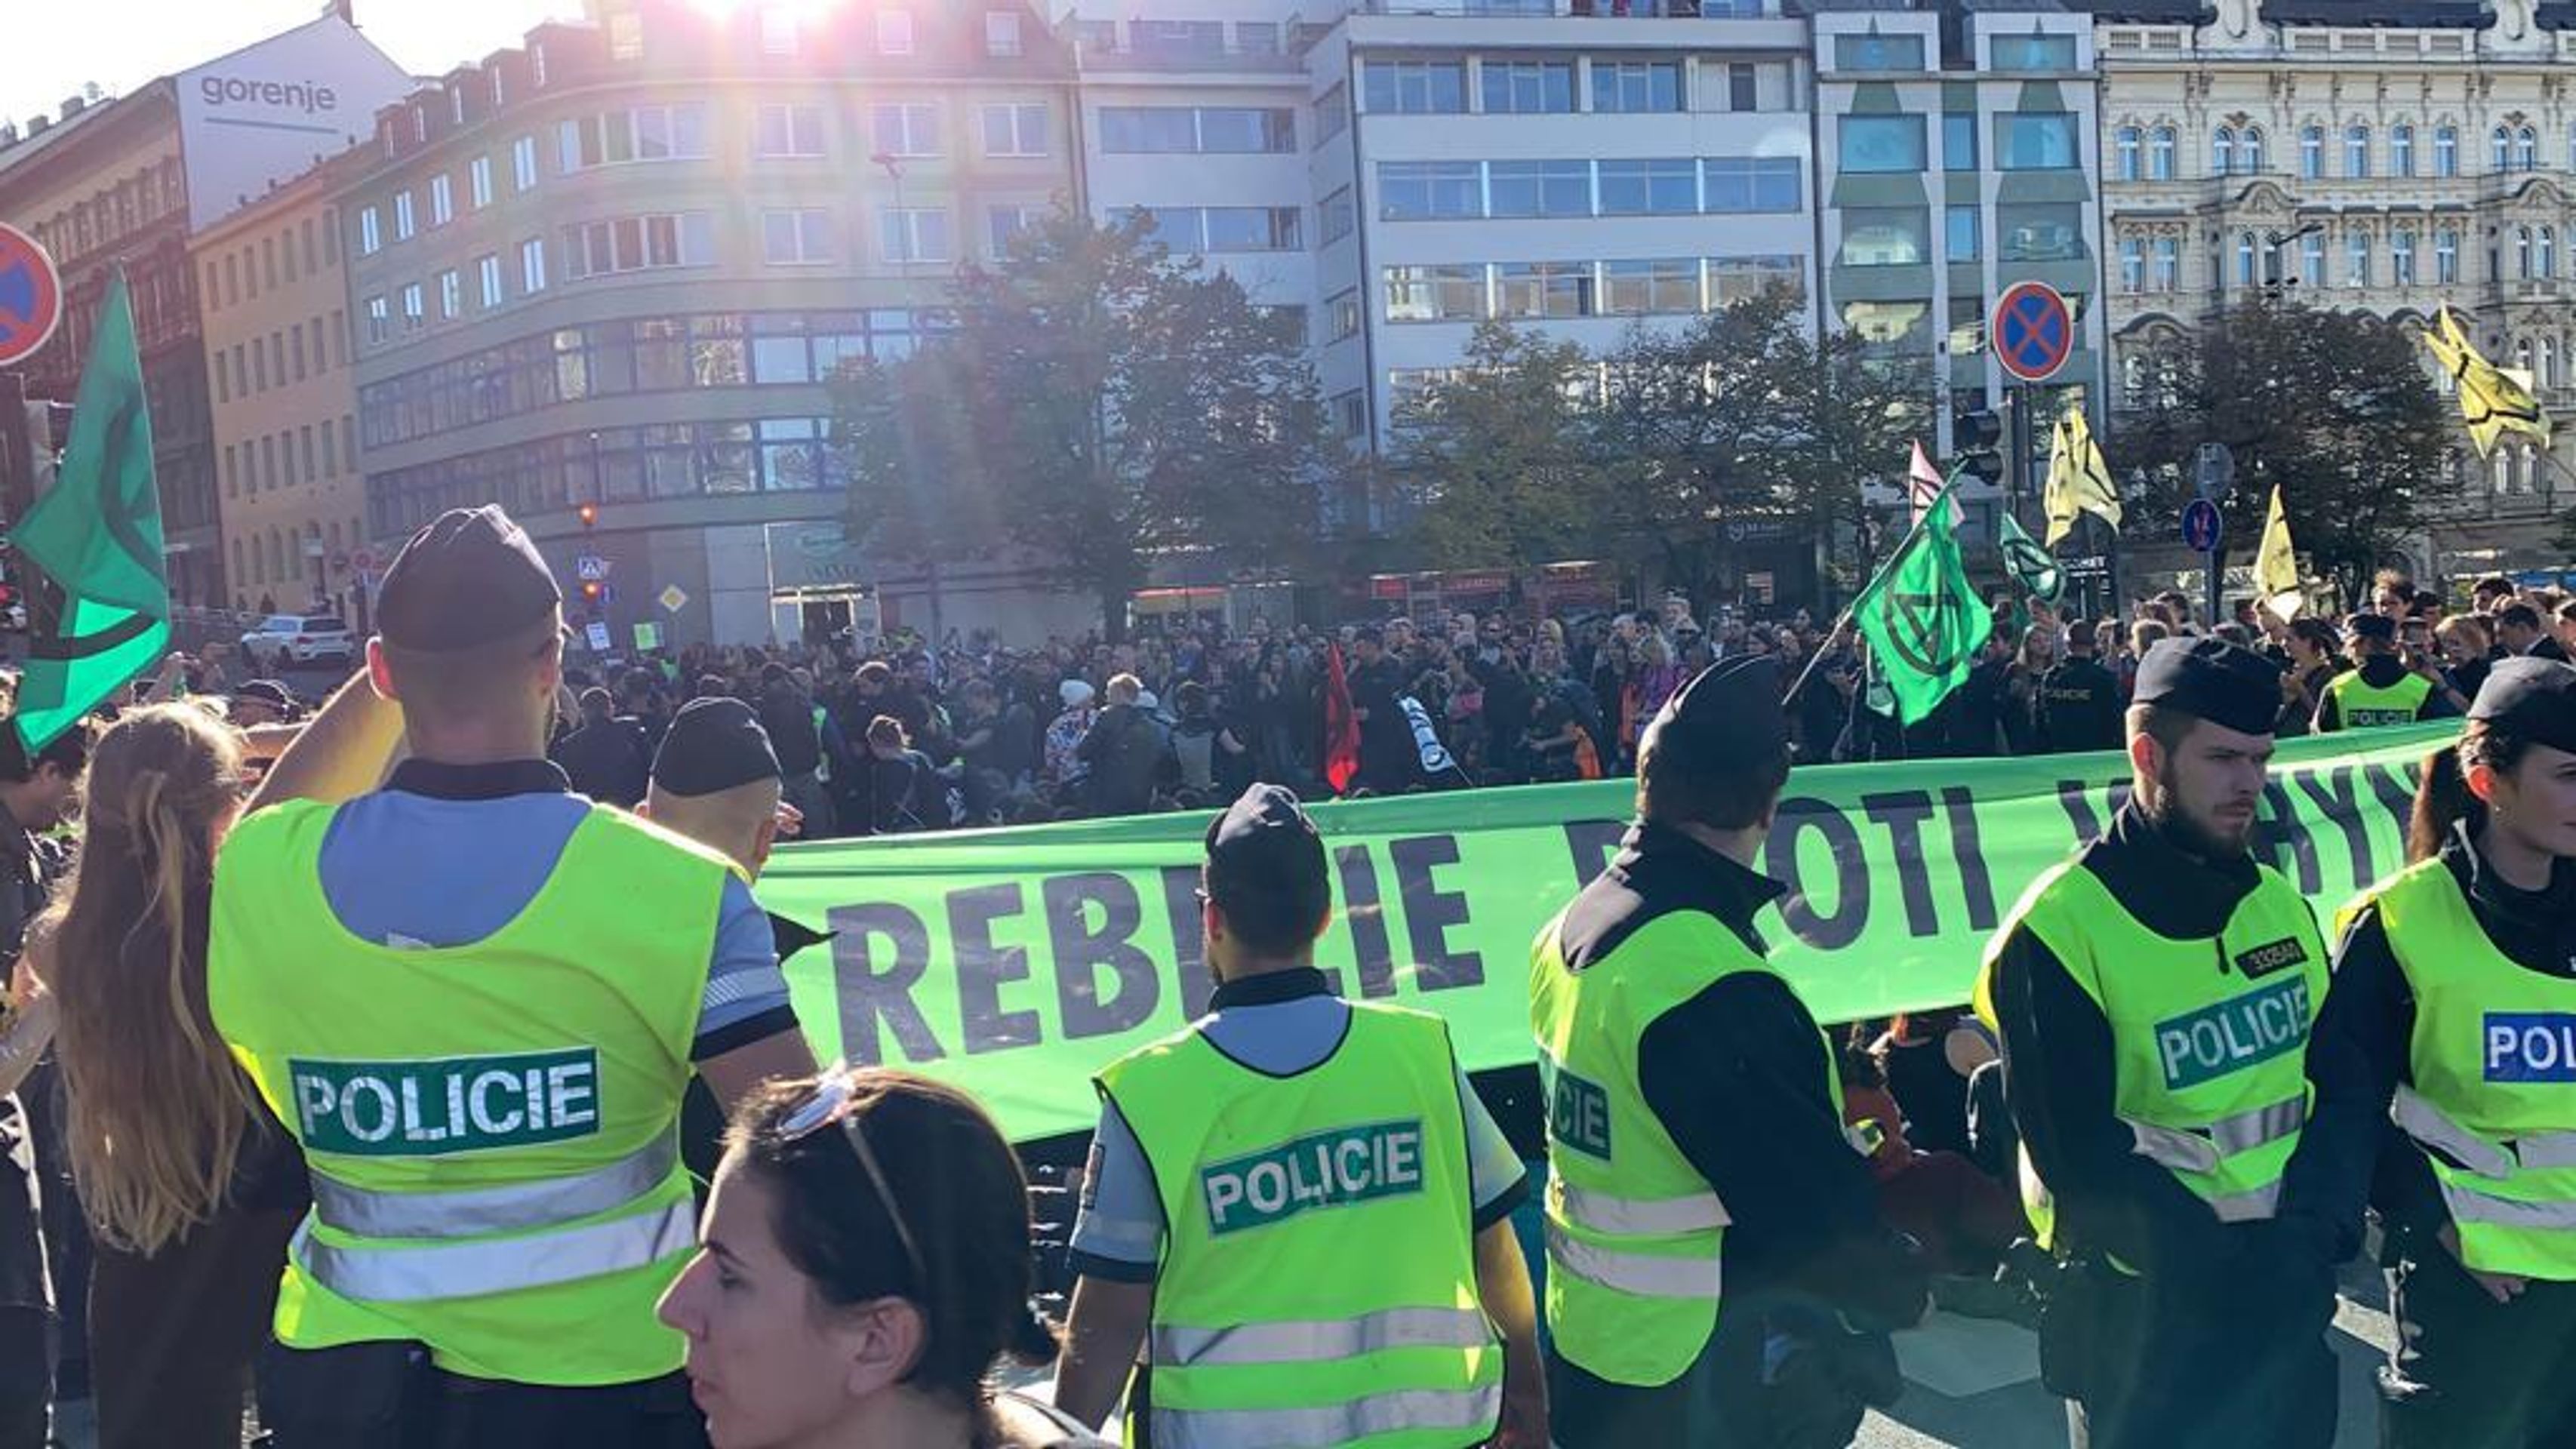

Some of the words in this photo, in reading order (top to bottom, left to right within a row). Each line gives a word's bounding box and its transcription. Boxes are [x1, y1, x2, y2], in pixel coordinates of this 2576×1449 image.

[201, 76, 336, 112] gorenje
[826, 834, 1485, 1066] REBIE
[1565, 786, 1998, 950] OTI
[2160, 983, 2310, 1080] POLICIE
[296, 1062, 596, 1143] POLICIE
[1207, 1131, 1418, 1224] POLICIE
